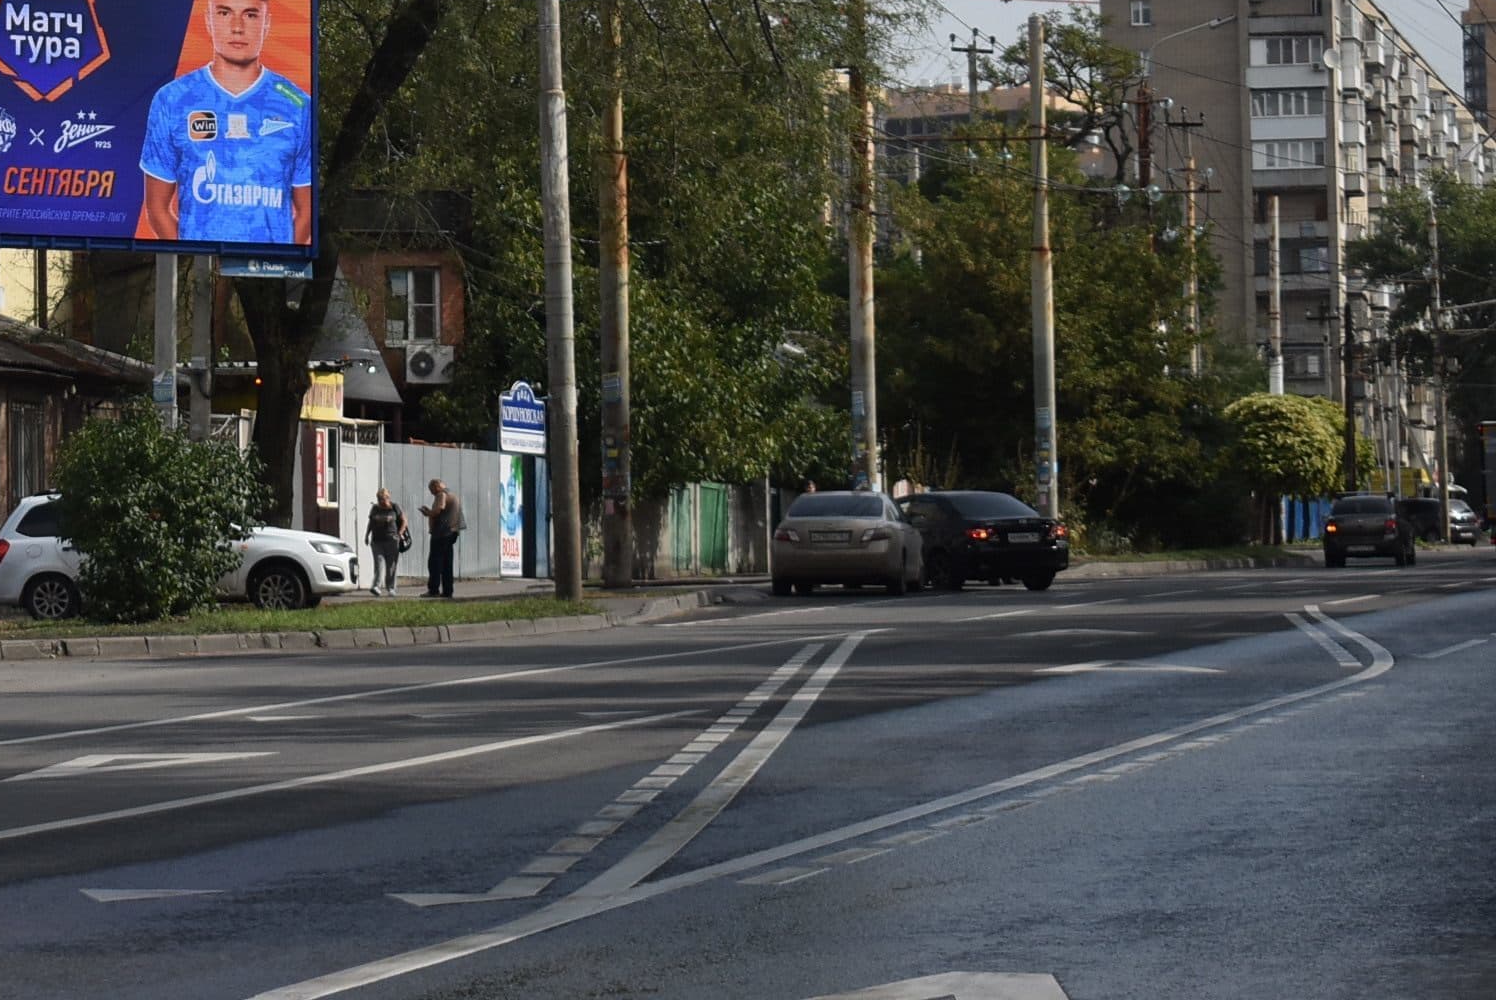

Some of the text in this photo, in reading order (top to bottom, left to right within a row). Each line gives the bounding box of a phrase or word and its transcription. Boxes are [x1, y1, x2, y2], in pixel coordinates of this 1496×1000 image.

[5, 3, 83, 34] Матч
[10, 35, 80, 64] тура
[4, 167, 115, 198] СЕНТЯБРЯ
[217, 184, 283, 208] ГАЗПРОМ
[22, 209, 71, 221] РОССИЙСКУЮ
